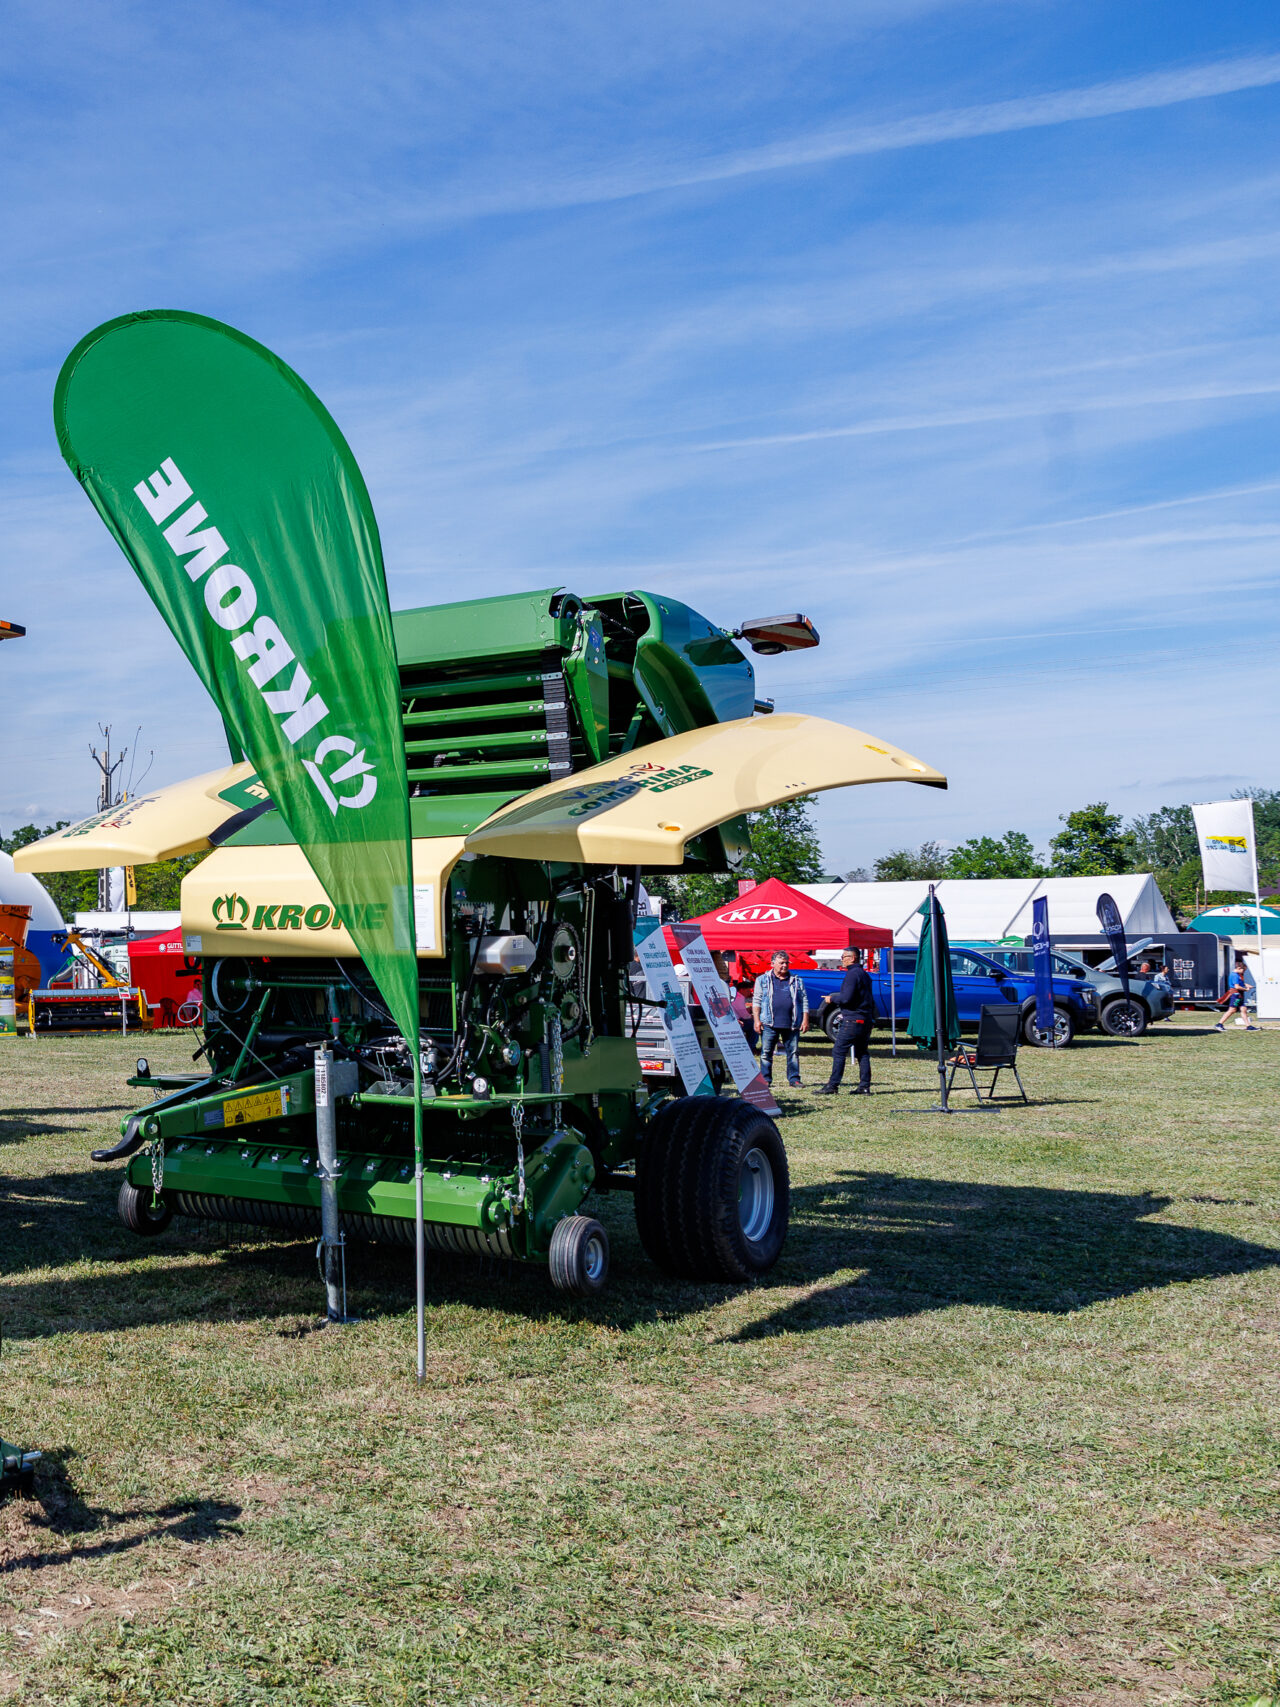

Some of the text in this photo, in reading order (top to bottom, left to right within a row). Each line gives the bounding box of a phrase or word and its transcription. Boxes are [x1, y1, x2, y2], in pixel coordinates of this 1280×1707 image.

[561, 771, 646, 801] Valkon
[568, 765, 701, 817] COMPRIMA
[252, 903, 388, 931] KRONE
[728, 908, 781, 922] KIA
